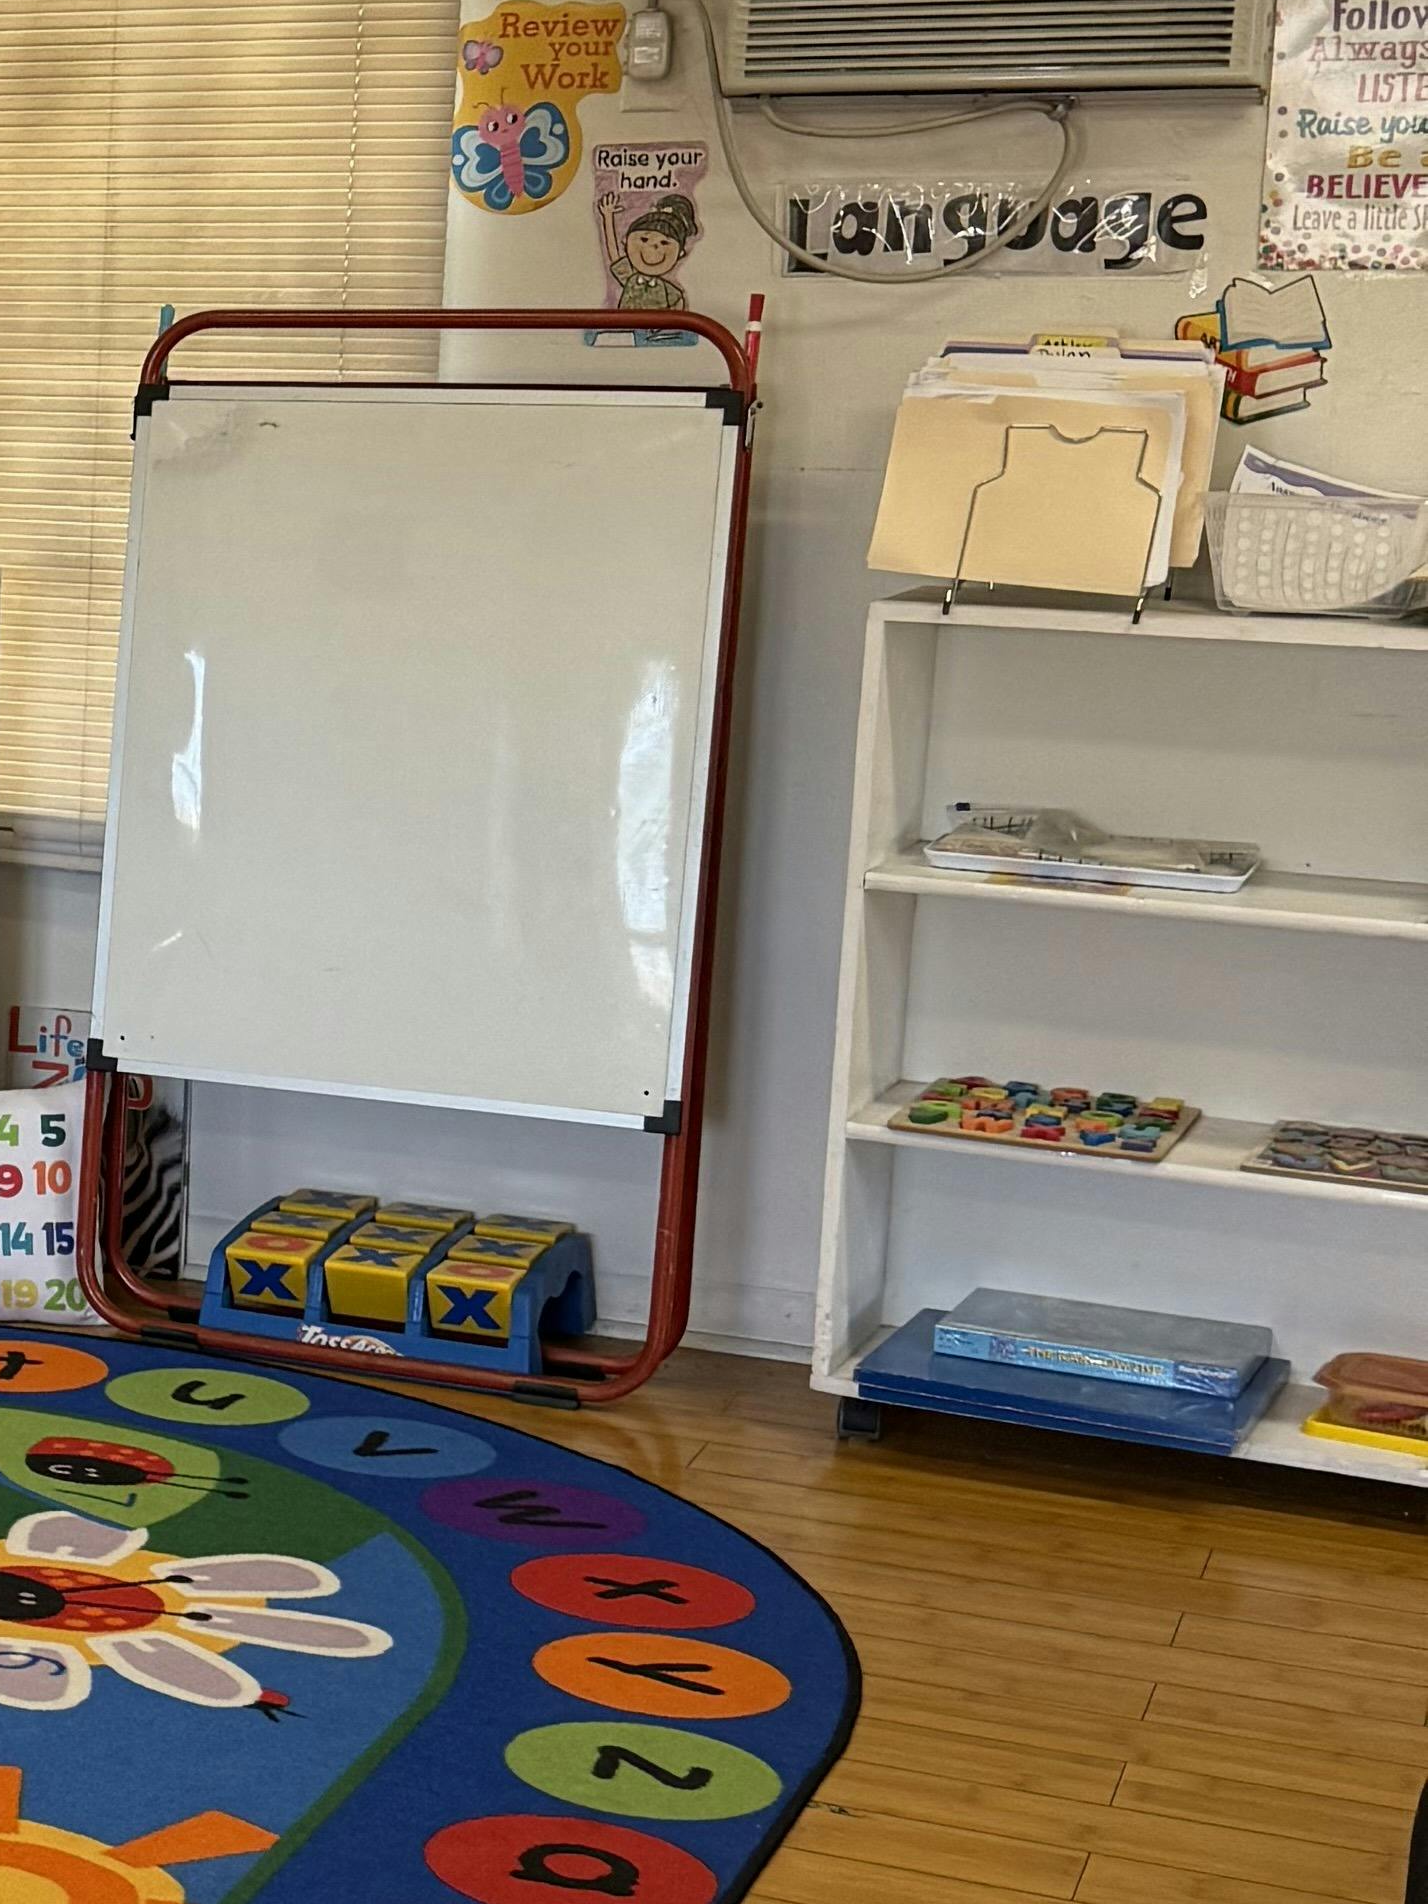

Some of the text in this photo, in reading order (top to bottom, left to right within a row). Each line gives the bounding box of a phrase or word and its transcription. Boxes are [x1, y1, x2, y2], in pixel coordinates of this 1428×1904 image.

[500, 12, 620, 38] Review
[548, 41, 615, 61] your
[1307, 36, 1428, 69] Always
[521, 63, 609, 90] Work
[1297, 109, 1372, 138] Raise
[598, 149, 703, 170] Raise your
[1347, 145, 1402, 168] Be
[620, 171, 677, 189] hand.
[1293, 204, 1408, 231] Leave a little
[787, 192, 1207, 272] Language
[8, 1005, 86, 1057] Life
[511, 1844, 639, 1897] a
